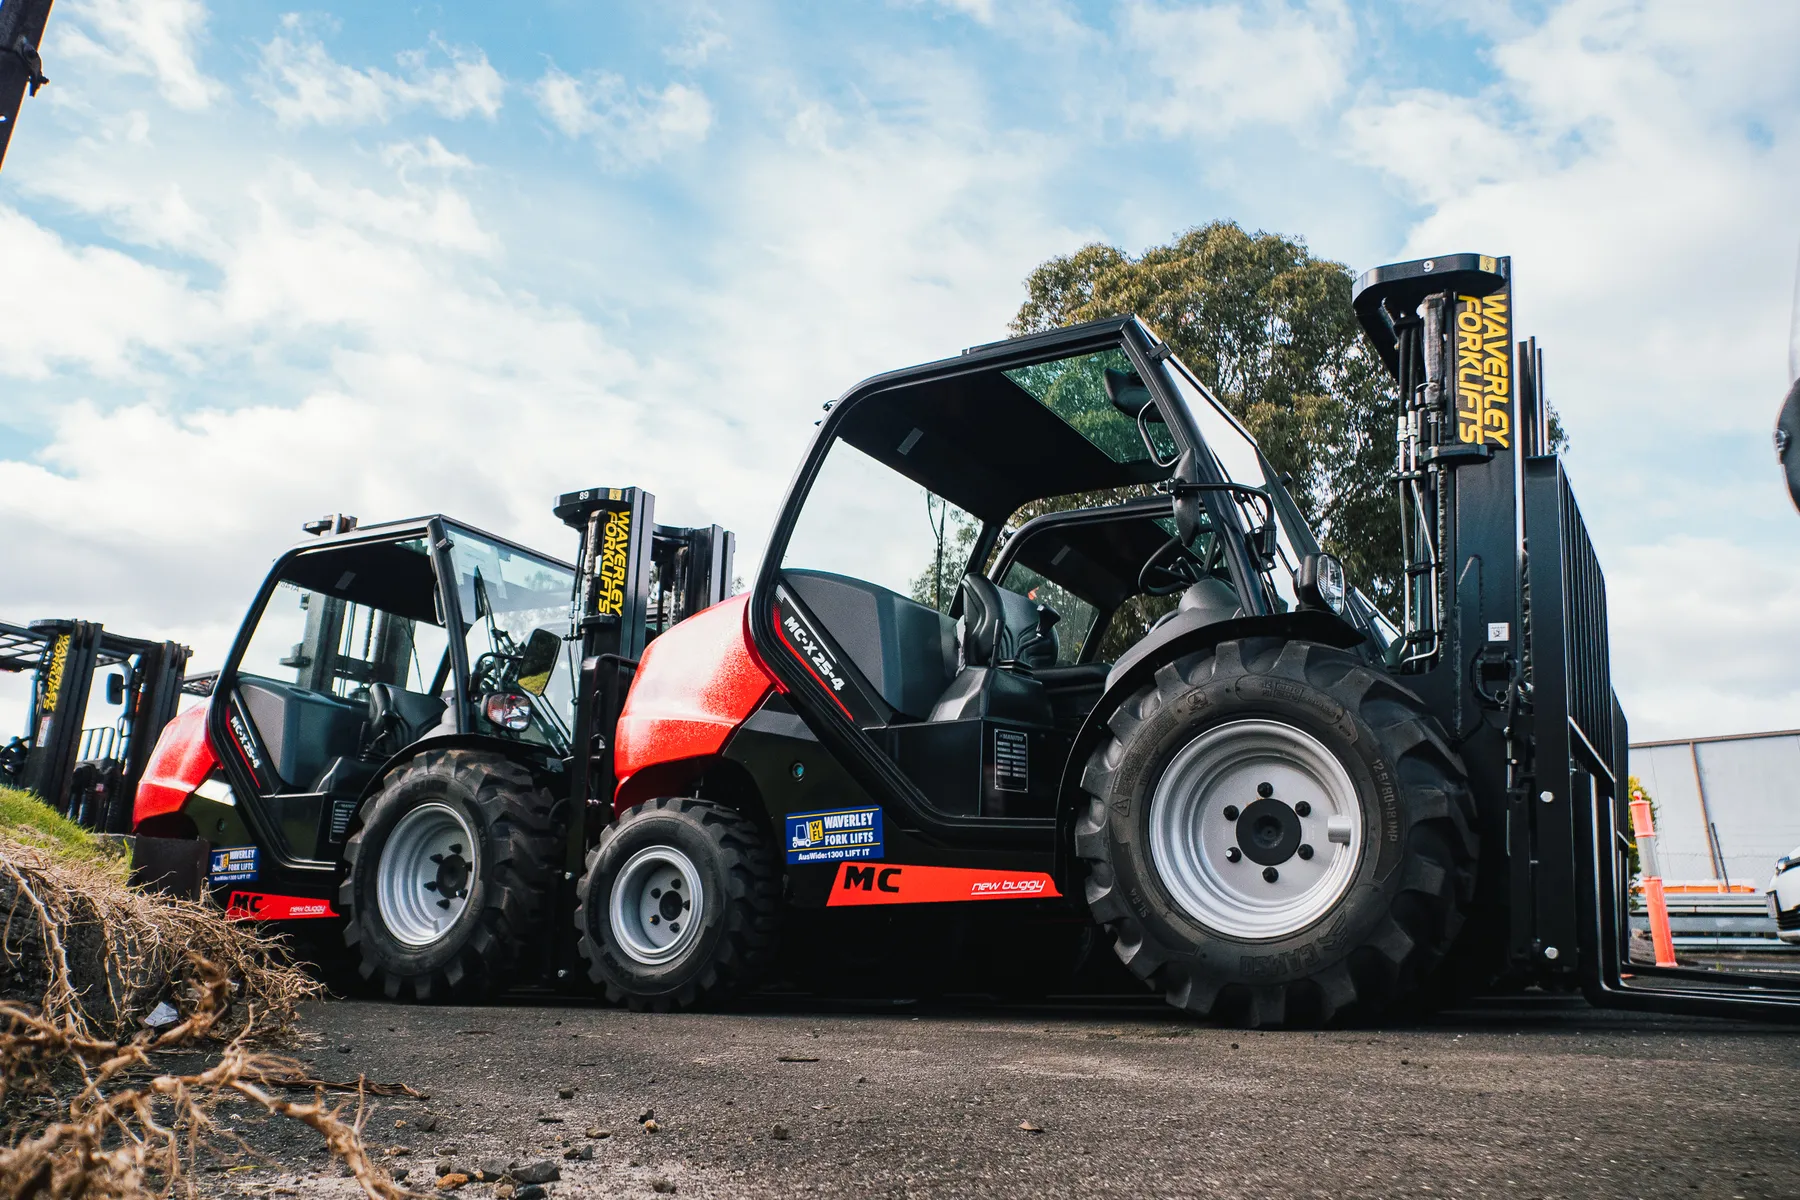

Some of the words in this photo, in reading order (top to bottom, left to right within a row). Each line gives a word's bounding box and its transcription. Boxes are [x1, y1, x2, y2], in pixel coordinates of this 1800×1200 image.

[1423, 260, 1435, 273] 9
[1457, 294, 1485, 446] FORKLIFTS
[1482, 293, 1510, 449] WAVERLEY
[579, 491, 590, 500] 89
[598, 511, 619, 615] FORKLIFTS
[610, 511, 631, 618] WAVERLEY
[783, 616, 818, 656] MC-X
[811, 652, 845, 691] 25-4
[48, 634, 71, 712] WAVERLEY
[823, 812, 874, 829] WAVERLEY
[824, 833, 848, 846] FORK
[849, 832, 874, 844] LIFTS
[845, 849, 861, 857] LIFT
[862, 848, 870, 856] IT
[843, 865, 902, 893] MC
[971, 881, 1001, 892] new
[1002, 879, 1046, 893] buggy
[232, 893, 263, 913] MC
